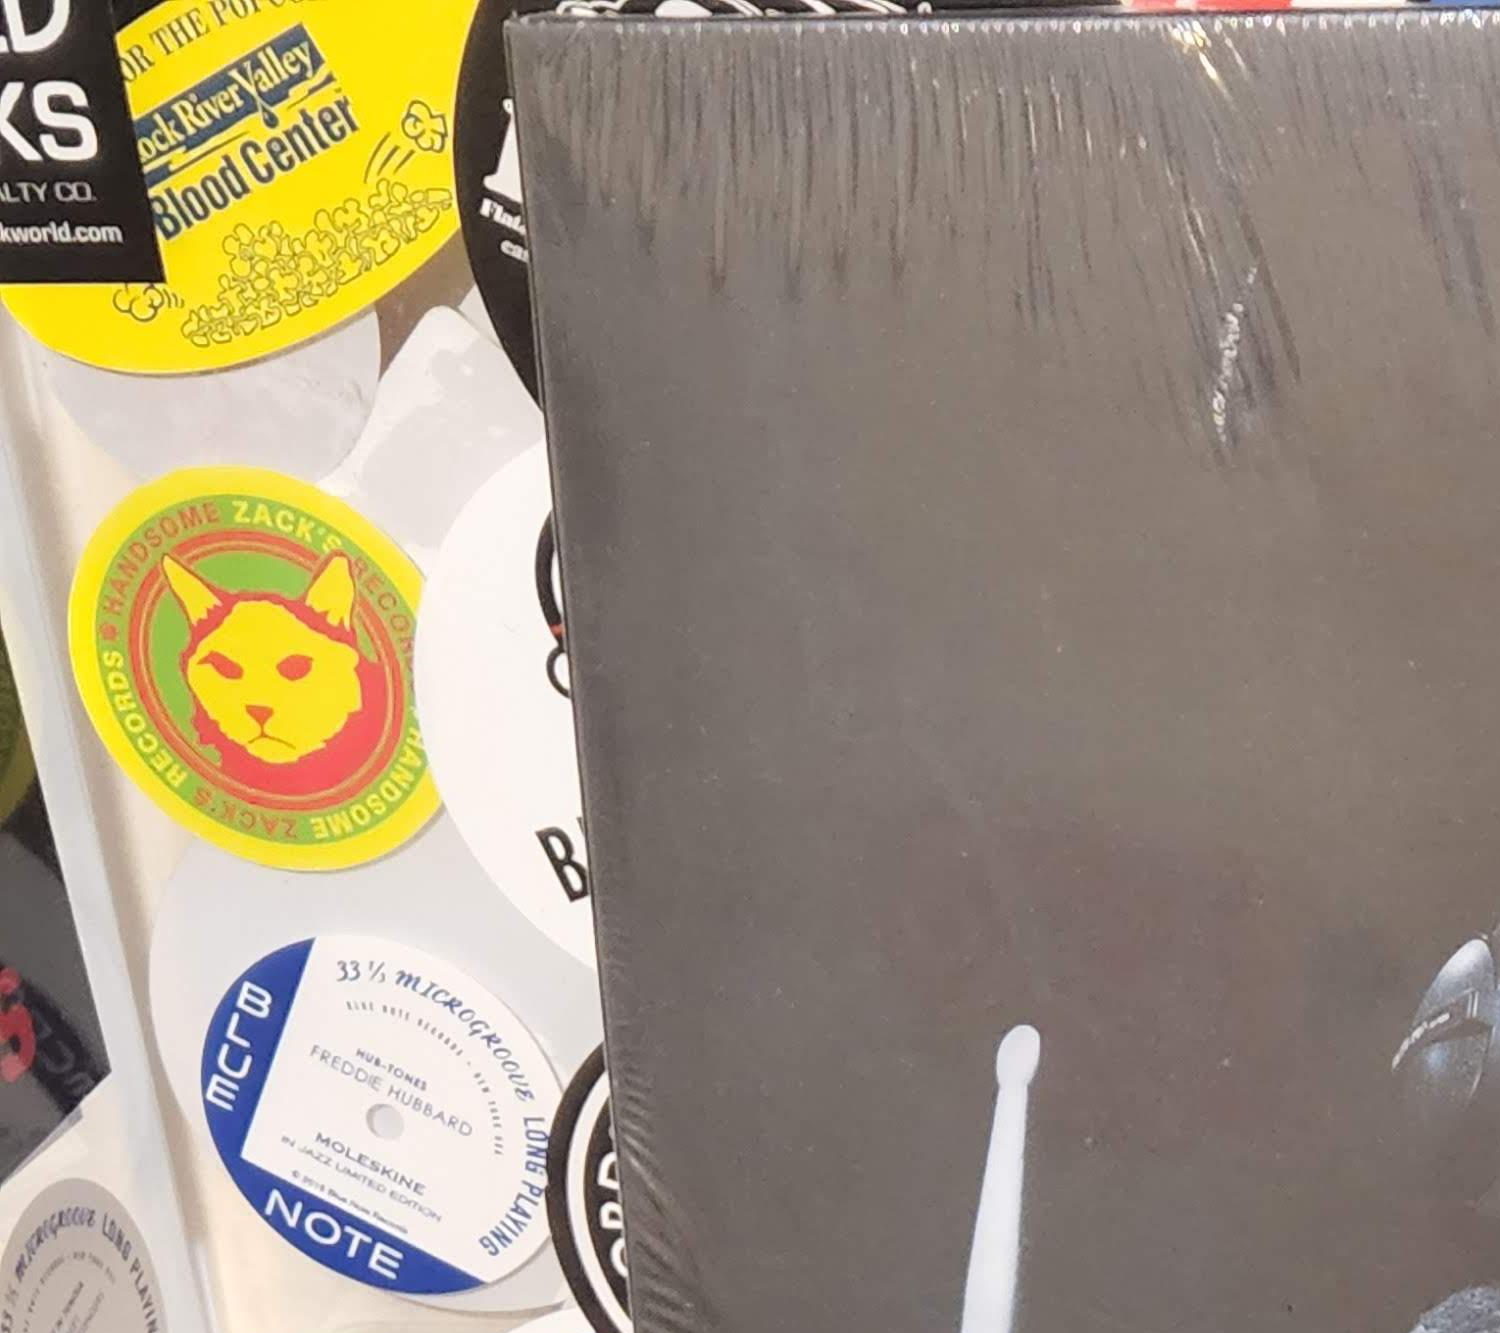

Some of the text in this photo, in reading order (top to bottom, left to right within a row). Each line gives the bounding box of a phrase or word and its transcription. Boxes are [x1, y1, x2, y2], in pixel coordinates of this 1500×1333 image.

[117, 41, 155, 84] OR
[149, 7, 211, 57] THE
[139, 41, 315, 162] ock River Valley
[54, 181, 96, 201] CO.
[150, 92, 360, 241] Blood Center
[102, 501, 221, 617] HANDSOME
[231, 500, 343, 553] ZACK'S
[103, 649, 429, 841] HANDSOME ZACK'S RECORDS
[336, 960, 361, 982] 33
[205, 980, 274, 1112] BLUE
[356, 1048, 428, 1091] HUB-TONES
[396, 969, 535, 1103] MICROGROOVE
[310, 1044, 474, 1137] FREDDIE HUBBARD
[315, 1131, 428, 1197] MOLESKINE
[522, 1116, 550, 1175] LONG
[264, 1188, 405, 1281] NOTE
[390, 1190, 443, 1223] EDITION
[479, 1179, 545, 1257] PLAYING
